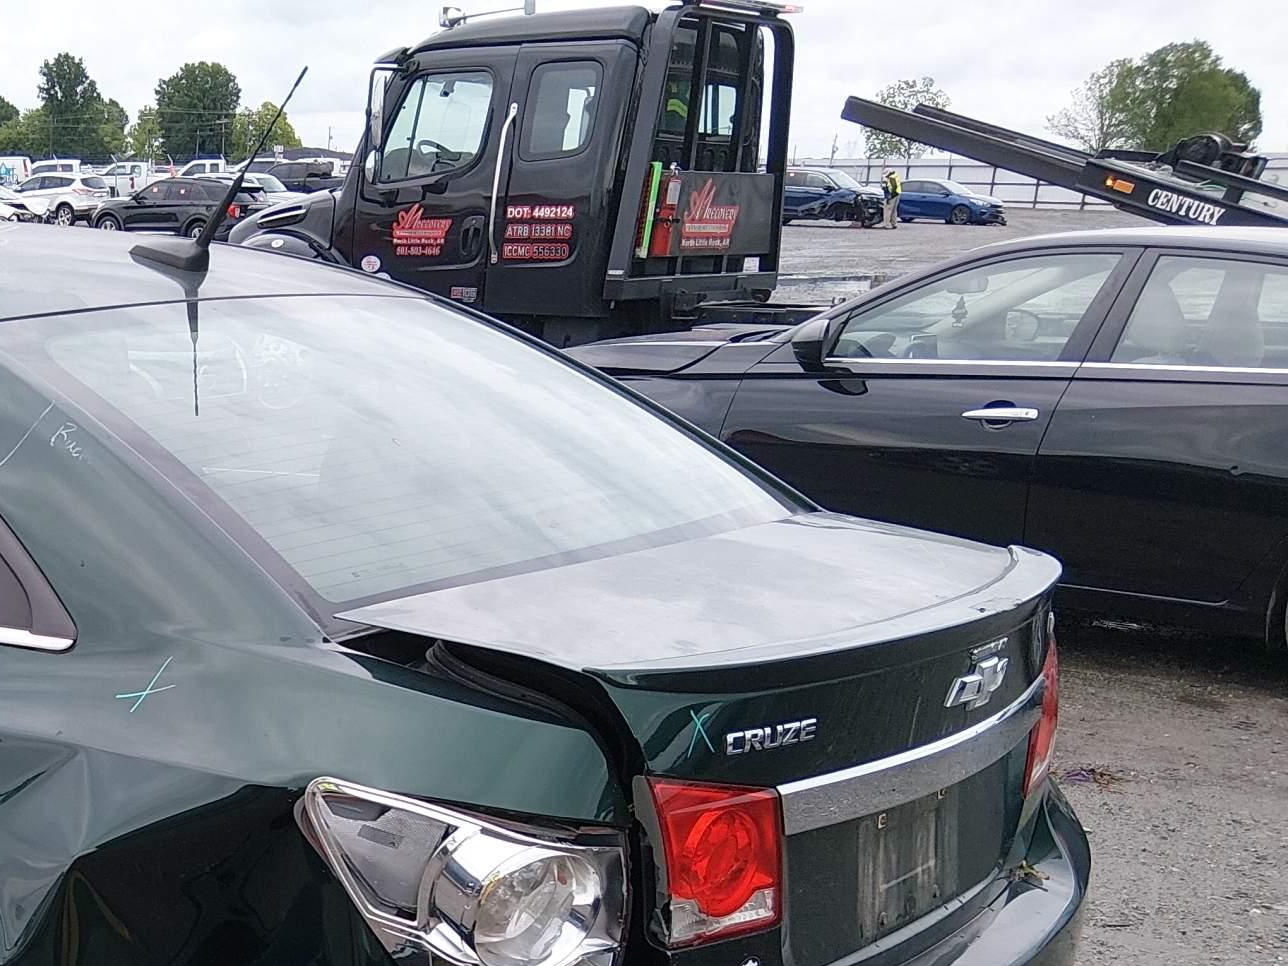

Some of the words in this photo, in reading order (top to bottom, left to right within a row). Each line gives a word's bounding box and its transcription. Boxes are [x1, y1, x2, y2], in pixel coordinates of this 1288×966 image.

[507, 207, 531, 218] DOT:
[533, 207, 574, 217] 4492124
[1147, 188, 1226, 226] CENTURY
[506, 226, 529, 237] ATRB
[557, 226, 572, 236] NC
[504, 246, 530, 256] ICCMC
[533, 246, 567, 257] 556330
[726, 718, 817, 756] CRUZE
